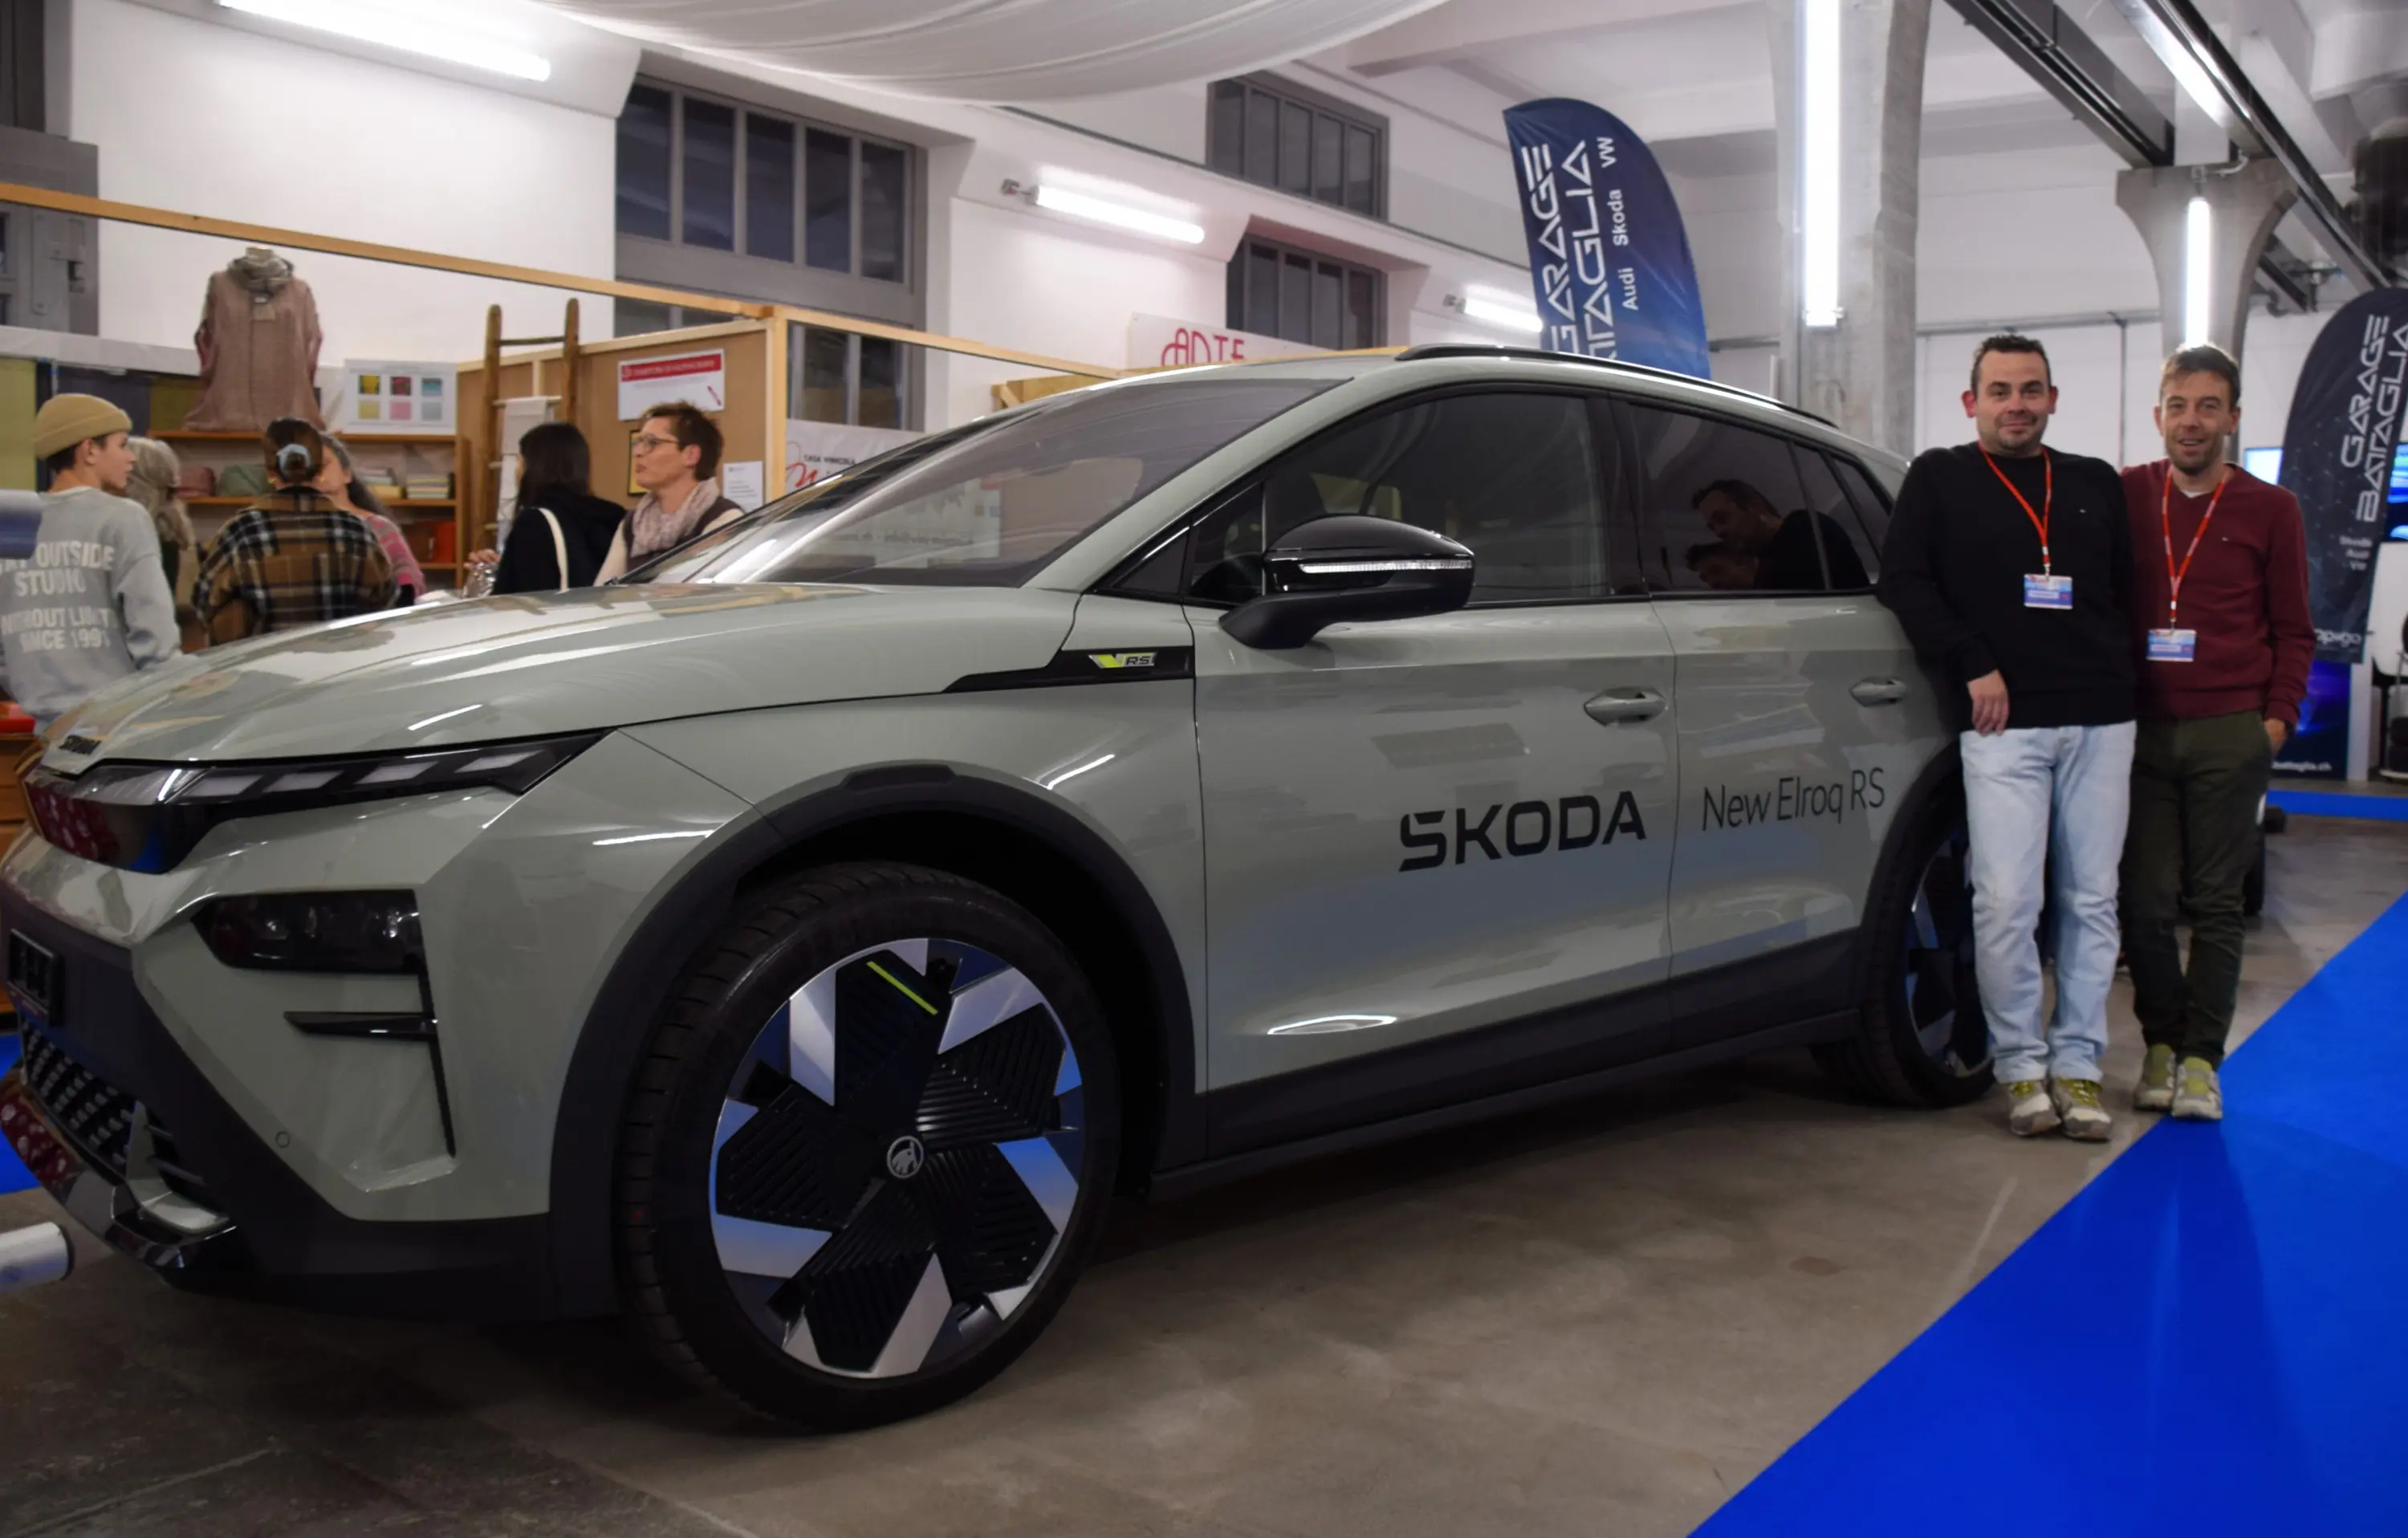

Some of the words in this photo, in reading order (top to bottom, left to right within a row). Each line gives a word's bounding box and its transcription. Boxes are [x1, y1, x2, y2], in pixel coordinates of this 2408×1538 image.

[1597, 136, 1617, 169] VW
[1607, 189, 1629, 246] Skoda
[1521, 142, 1580, 355] GARAGE
[1617, 267, 1639, 311] Audi
[2341, 314, 2390, 468] GARAGE
[36, 540, 115, 571] OUTSIDE
[1702, 784, 1771, 832] New
[1777, 776, 1844, 824] Elroq
[1851, 767, 1885, 809] RS
[1399, 790, 1646, 873] SKODA
